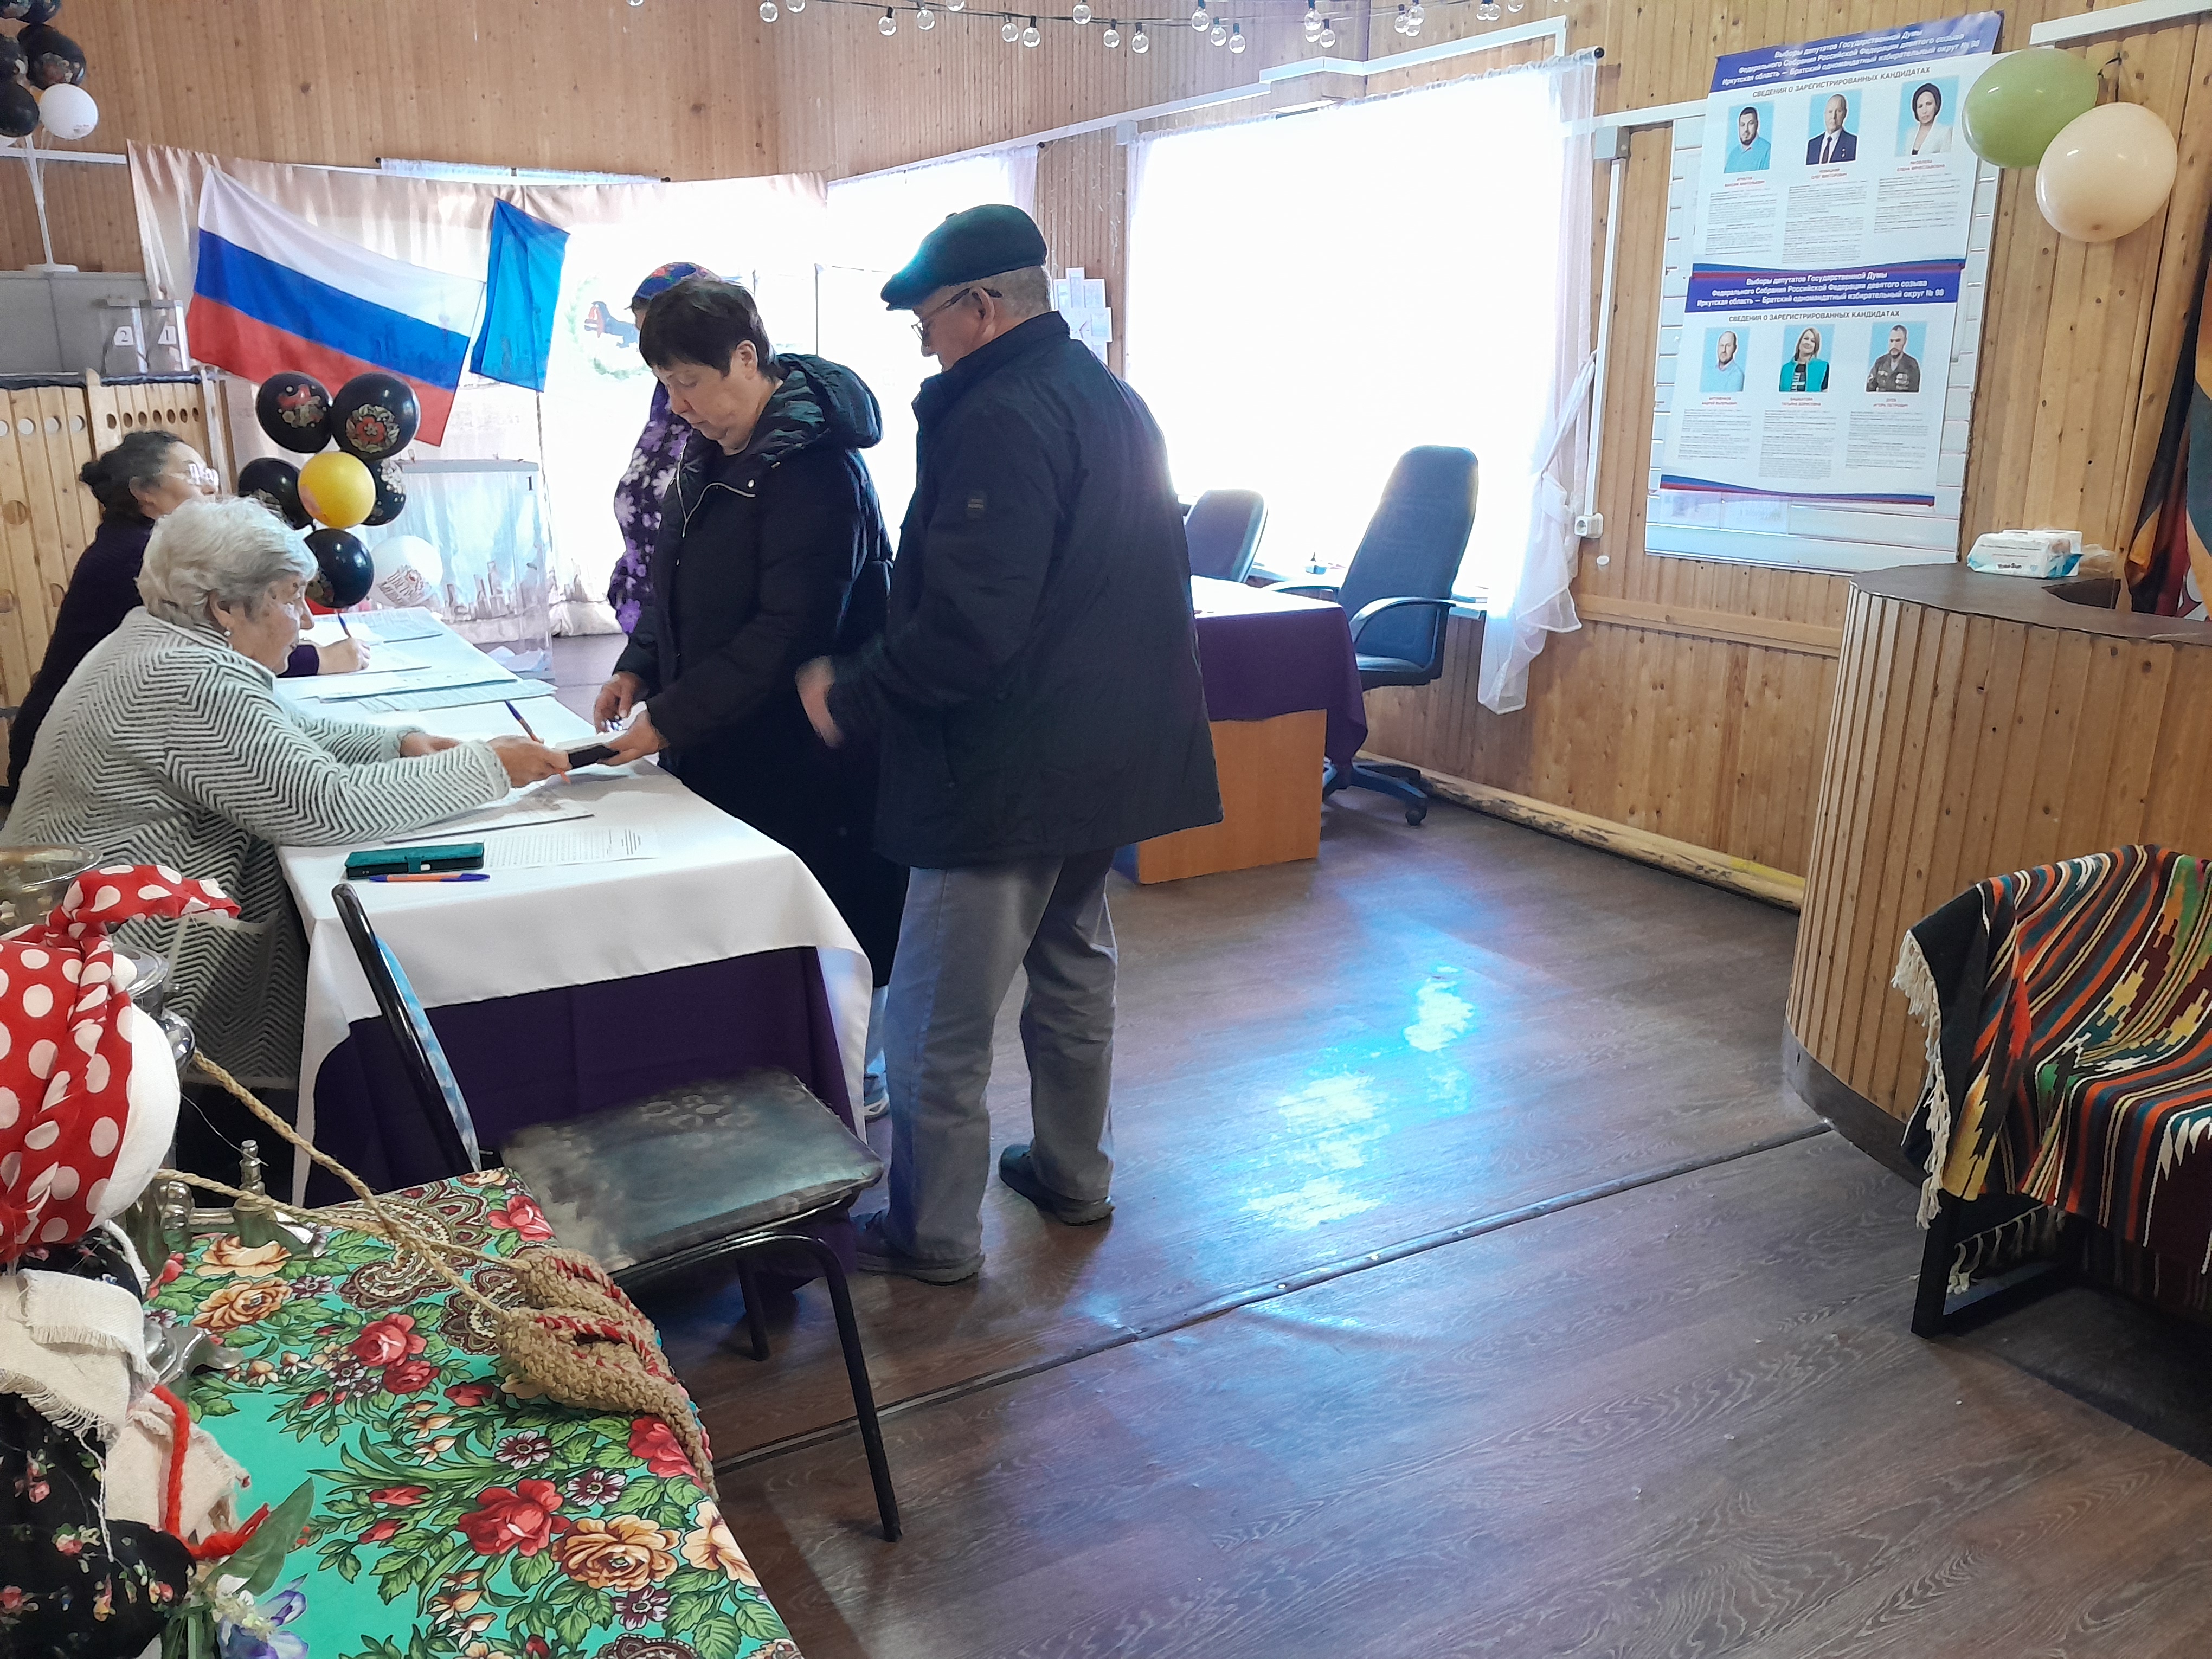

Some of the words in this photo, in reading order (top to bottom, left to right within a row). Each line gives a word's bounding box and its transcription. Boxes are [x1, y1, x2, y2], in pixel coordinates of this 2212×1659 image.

[1901, 30, 1923, 40] Думы
[1937, 44, 1959, 53] округ
[1752, 87, 1787, 98] СВЕДЕНИЯ
[1795, 74, 1878, 92] ЗАРЕГИСТРИРОВАННЫХ
[1880, 67, 1930, 79] КАНДИДАТАХ
[1867, 272, 1887, 280] Думы
[1787, 284, 1827, 293] Российской
[1903, 290, 1924, 298] округ
[1770, 312, 1849, 321] ЗАРЕГИСТРИРОВАННЫХ
[120, 330, 128, 342] 2
[165, 329, 169, 342] 1
[527, 475, 533, 491] 1
